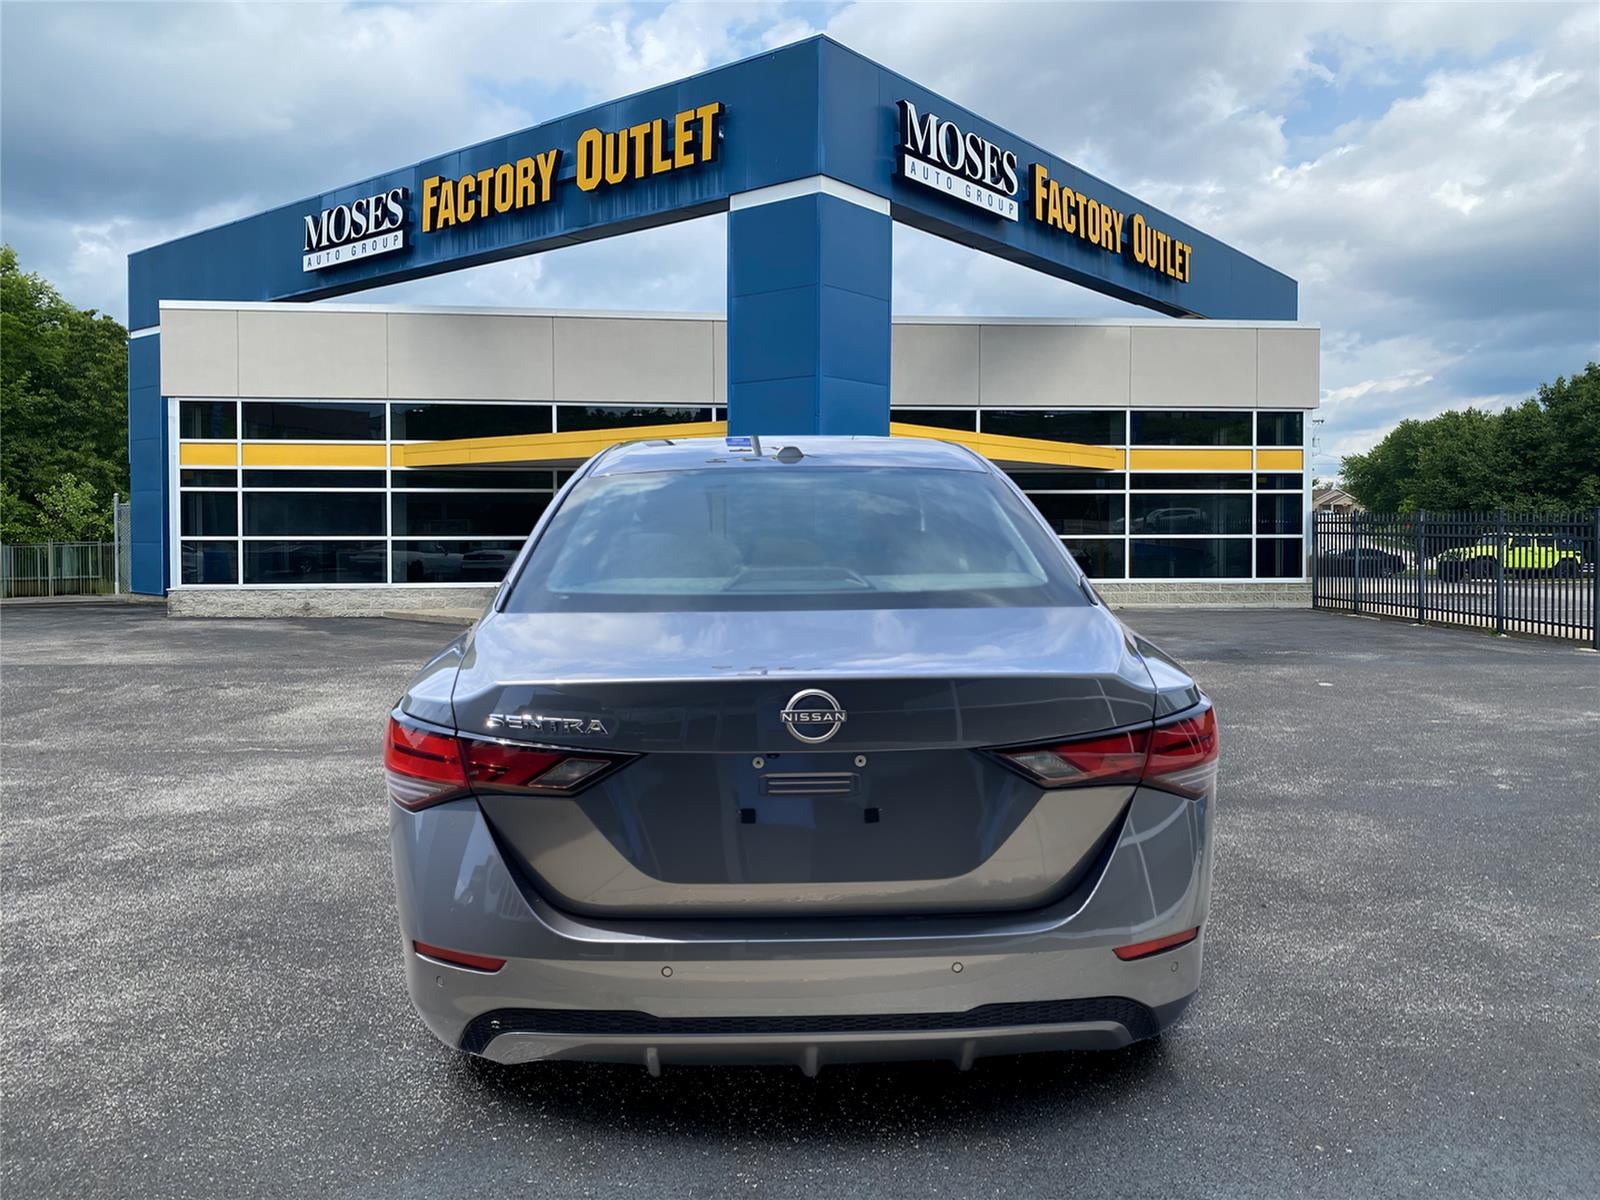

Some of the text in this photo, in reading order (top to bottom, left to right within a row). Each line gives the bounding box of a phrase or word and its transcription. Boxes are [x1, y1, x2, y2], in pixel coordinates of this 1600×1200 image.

[422, 102, 720, 232] FACTORY OUTLET
[904, 100, 1019, 196] MOSES
[910, 161, 1014, 215] AUTO GROUP
[303, 187, 404, 252] MOSES
[1034, 163, 1191, 283] FACTORY OUTLET
[307, 234, 400, 268] AUTO GROUP
[486, 713, 609, 735] SENTRA
[781, 711, 846, 722] NISSAN
